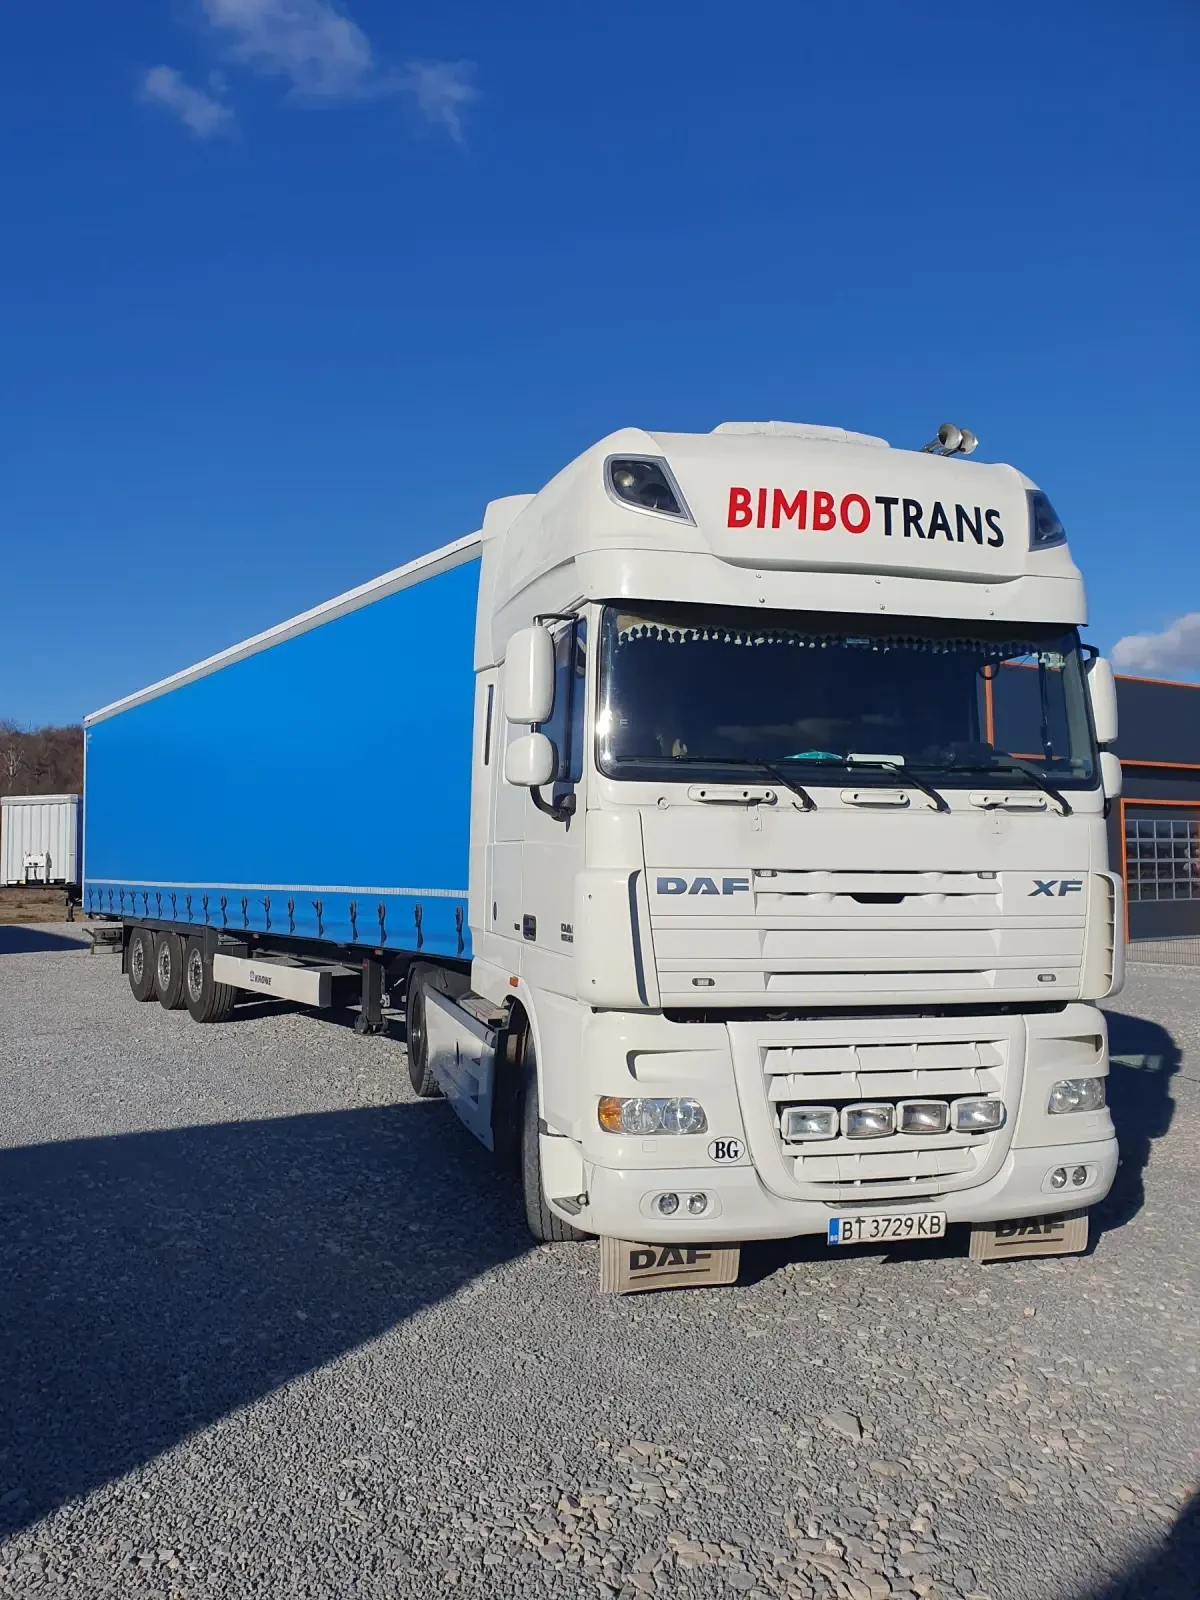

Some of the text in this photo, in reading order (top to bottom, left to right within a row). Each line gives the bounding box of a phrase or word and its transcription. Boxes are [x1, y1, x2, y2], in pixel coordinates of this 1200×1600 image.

[657, 877, 749, 895] DAF
[1026, 880, 1083, 896] XF
[561, 922, 574, 934] DA
[714, 1140, 740, 1159] BG
[870, 1217, 914, 1238] 3729
[629, 1245, 712, 1270] DAF
